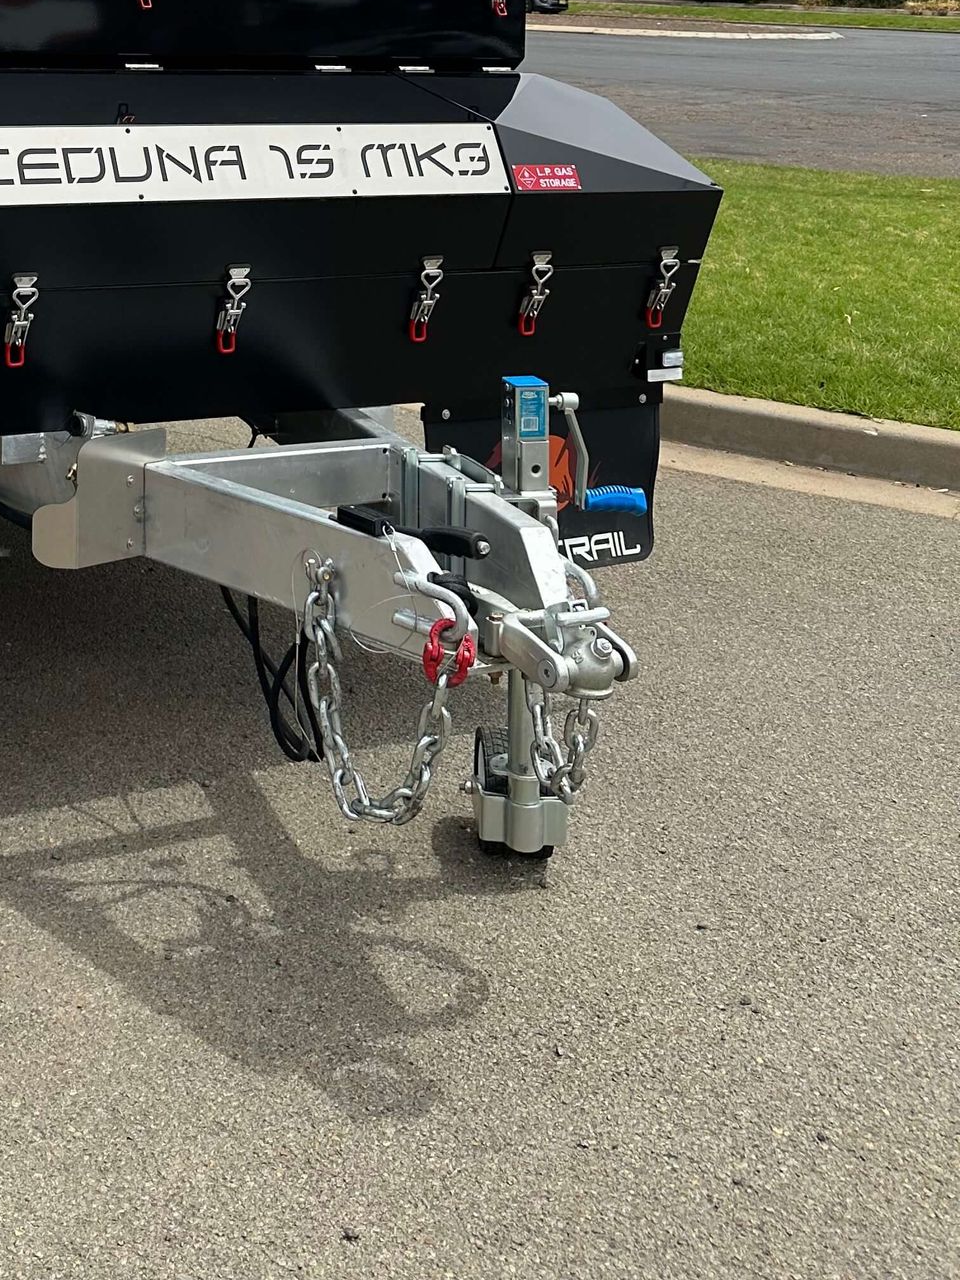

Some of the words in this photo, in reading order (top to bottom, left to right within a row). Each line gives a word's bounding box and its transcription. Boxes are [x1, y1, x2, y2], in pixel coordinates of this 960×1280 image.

[536, 167, 552, 177] L.P.
[554, 167, 573, 176] GAS
[539, 178, 577, 187] STORAGE
[558, 531, 641, 563] RAIL
